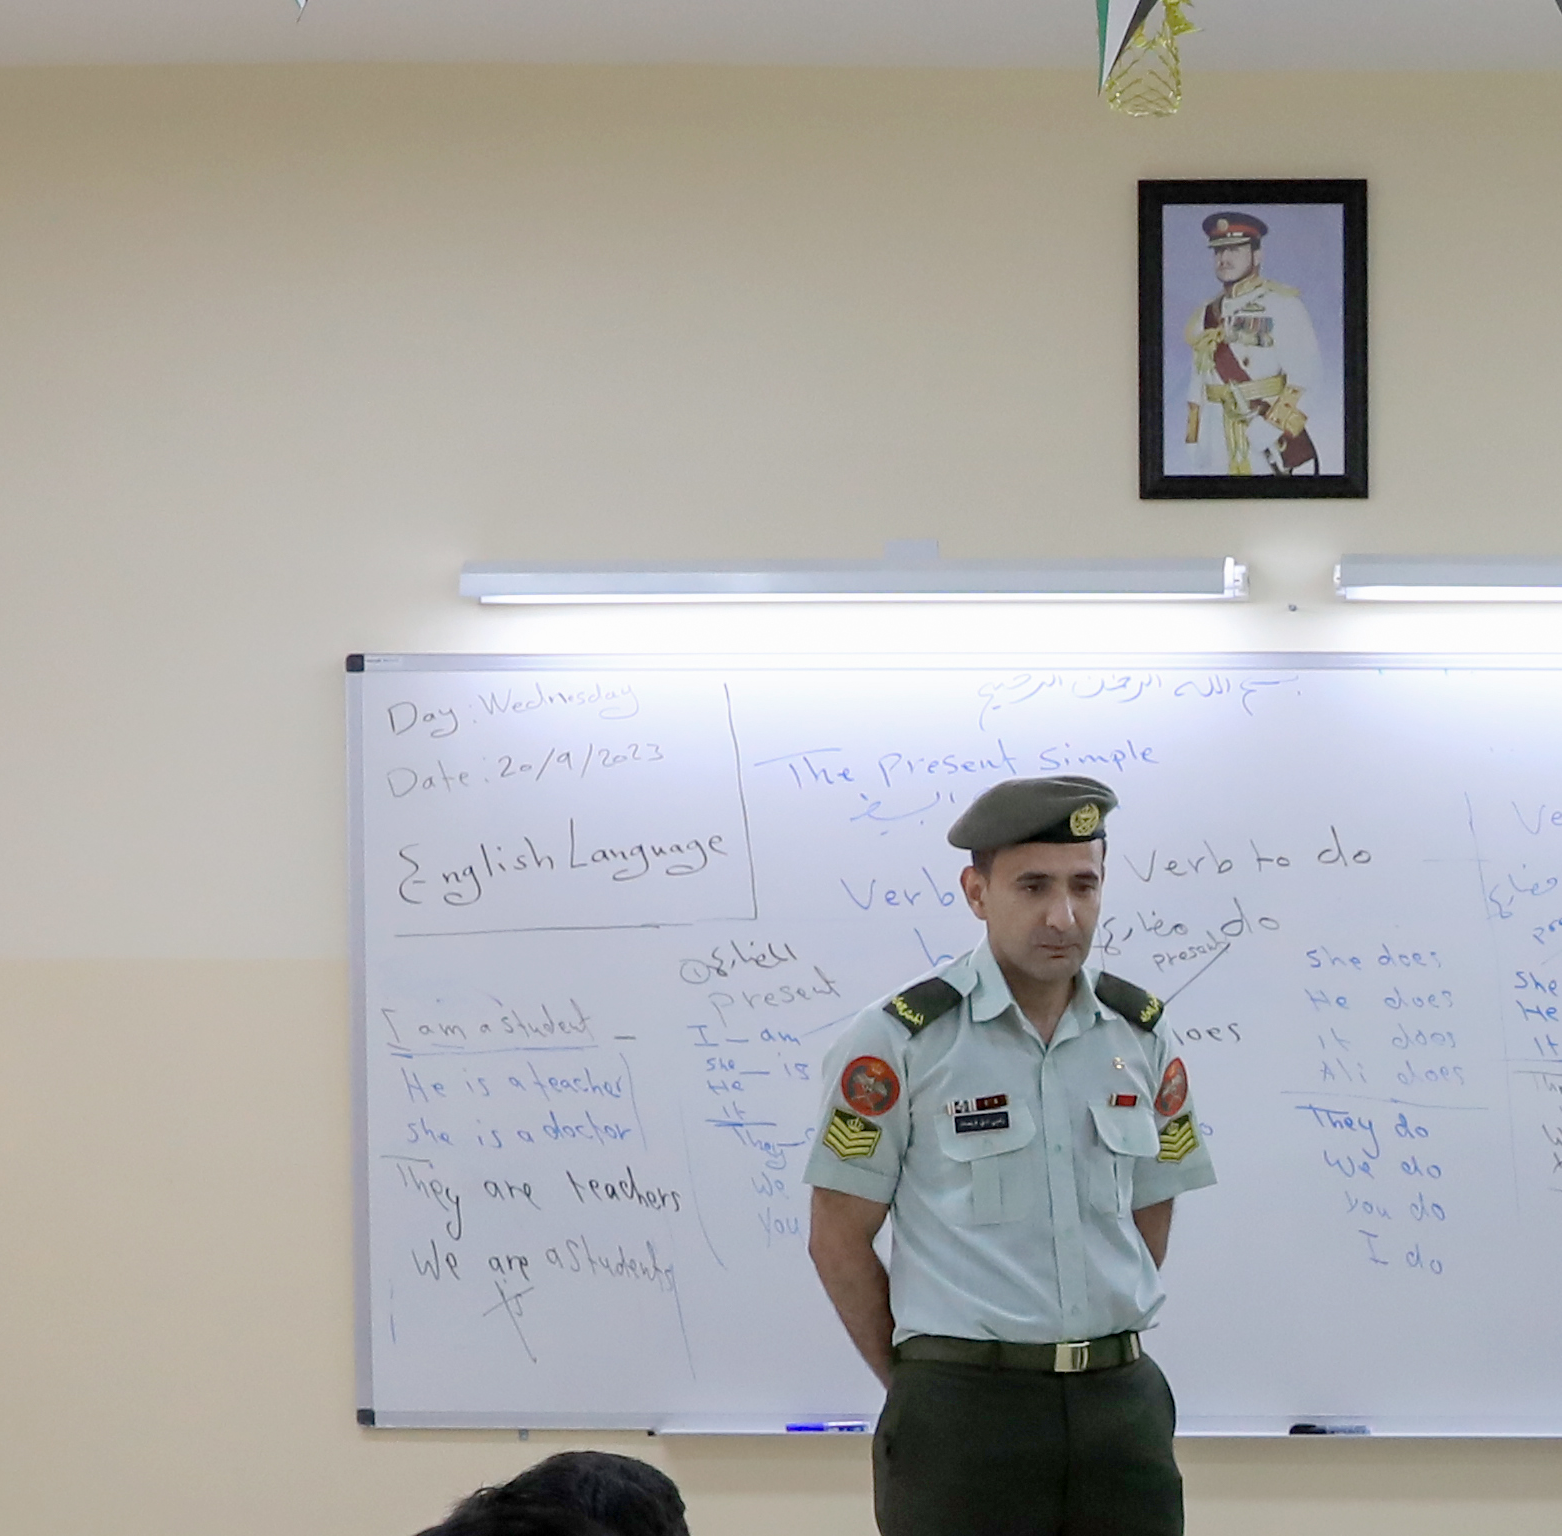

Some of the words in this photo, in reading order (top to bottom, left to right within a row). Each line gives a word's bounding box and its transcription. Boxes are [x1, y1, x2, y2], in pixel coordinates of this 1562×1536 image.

[478, 681, 639, 720] Wednesday
[1174, 673, 1231, 698] الله
[496, 742, 665, 783] 20/9/2023
[754, 746, 855, 790] The
[397, 835, 555, 907] English
[569, 817, 729, 883] Language
[1249, 837, 1291, 873] to
[1316, 824, 1373, 868] do
[1220, 896, 1281, 938] do
[1305, 986, 1351, 1011] He
[1382, 986, 1455, 1010] does
[1514, 998, 1559, 1024] He
[418, 1019, 466, 1042] am
[499, 999, 593, 1045] student
[759, 1029, 802, 1046] am
[400, 1066, 447, 1104] He
[465, 1061, 492, 1097] is
[526, 1061, 624, 1099] teacher
[706, 1078, 745, 1097] He
[477, 1118, 505, 1150] is
[518, 1125, 537, 1144] a
[543, 1110, 634, 1148] doctor
[1294, 1103, 1381, 1161] They
[1394, 1113, 1431, 1140] do
[1323, 1149, 1375, 1181] We
[1401, 1155, 1444, 1181] do
[380, 1153, 464, 1241] They
[483, 1178, 542, 1211] are
[565, 1165, 683, 1214] teachers
[1409, 1190, 1447, 1222] do
[412, 1240, 460, 1282] We
[487, 1246, 531, 1283] are
[1405, 1242, 1444, 1276] do
